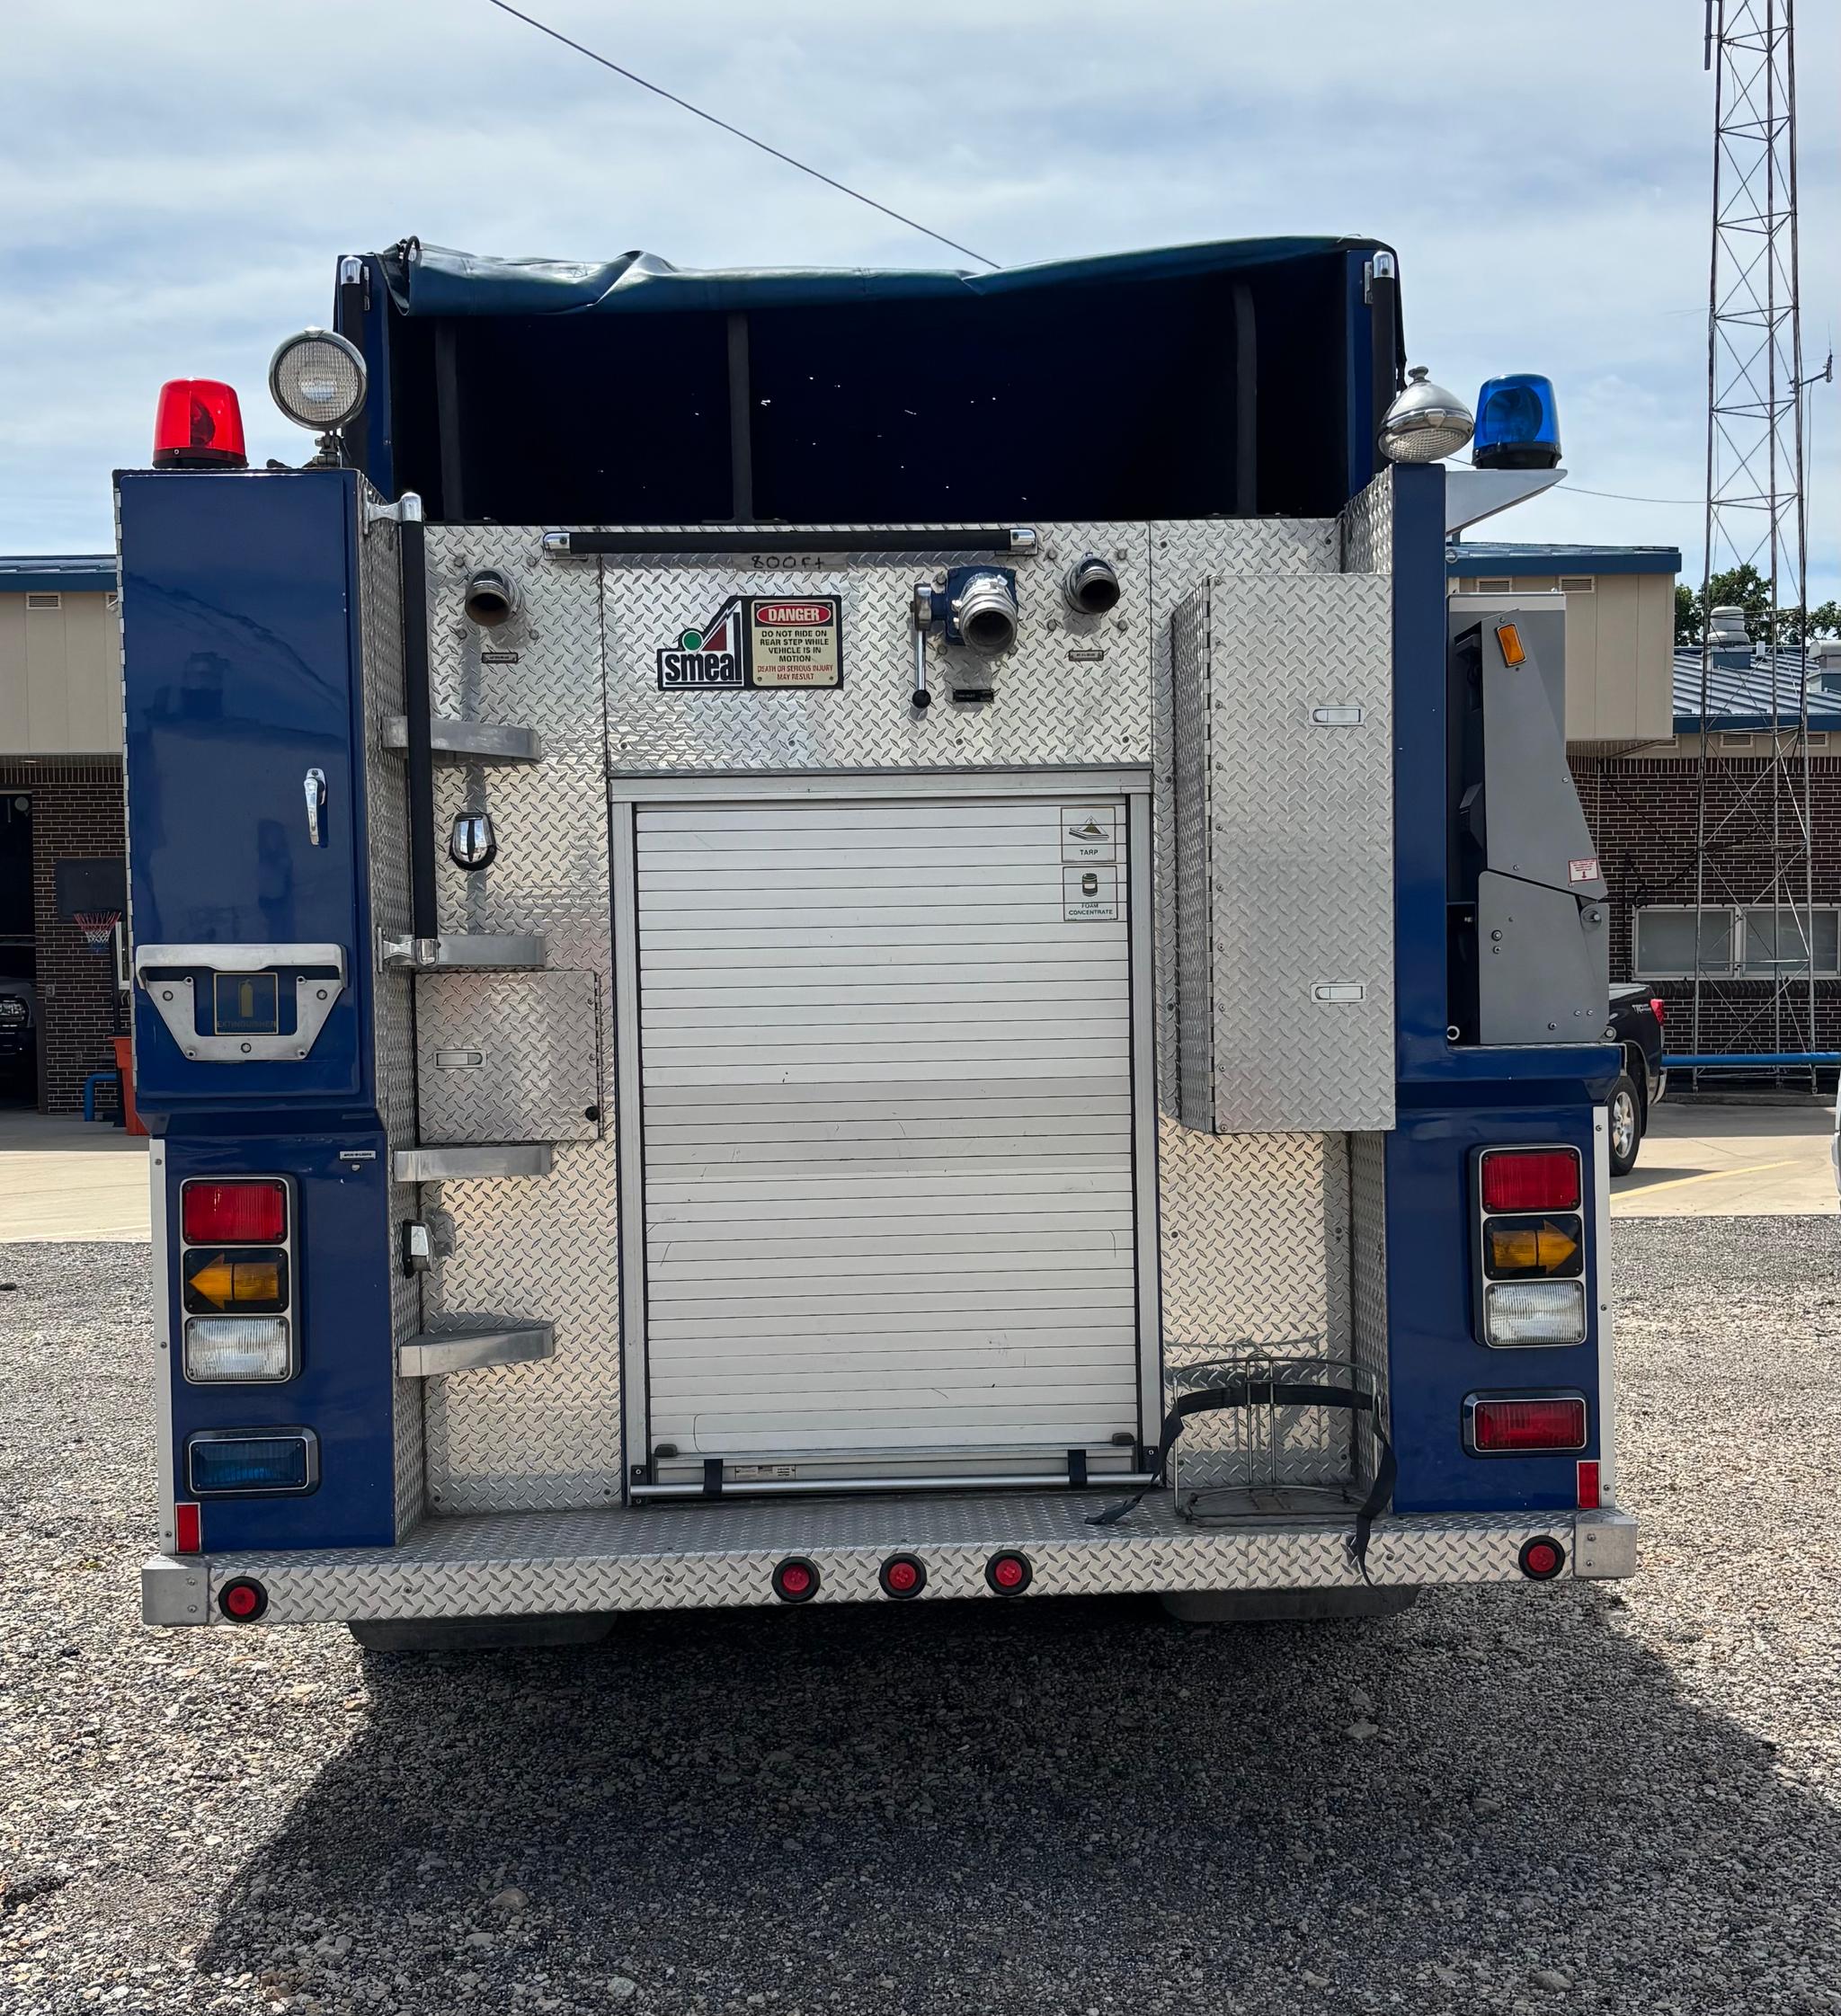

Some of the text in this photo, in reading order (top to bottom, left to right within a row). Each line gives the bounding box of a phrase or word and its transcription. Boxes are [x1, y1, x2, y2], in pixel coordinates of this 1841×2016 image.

[768, 608, 820, 622] DANGER
[761, 630, 774, 638] DO
[776, 630, 792, 638] NOT
[757, 665, 777, 673] DEATH
[813, 664, 833, 672] INJURY
